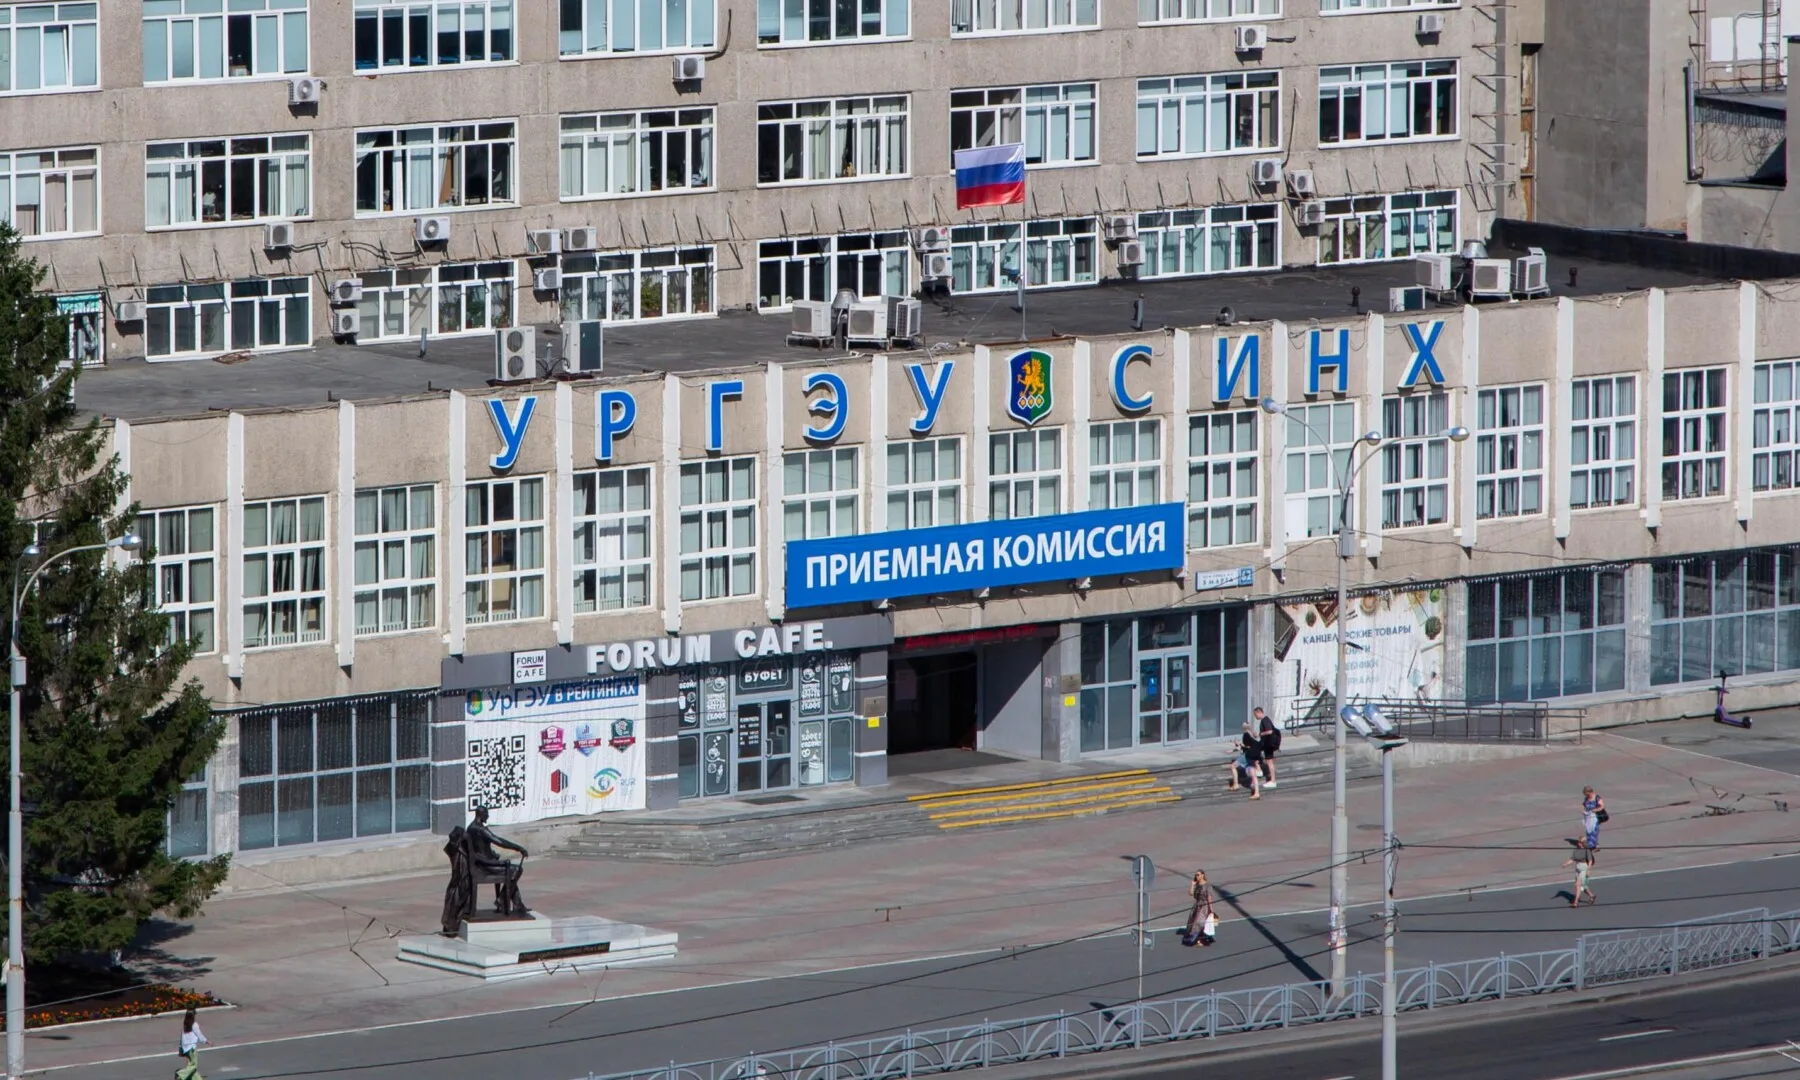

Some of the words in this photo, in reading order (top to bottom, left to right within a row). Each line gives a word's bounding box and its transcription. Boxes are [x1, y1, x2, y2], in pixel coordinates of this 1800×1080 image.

[806, 539, 984, 589] ПРИЕМНАЯ
[993, 520, 1166, 569] КОМИССИЯ
[586, 634, 711, 675] FORUM
[734, 622, 834, 658] CAFE.
[1303, 628, 1373, 645] КАНЦЕЛРСКИЕ
[1375, 625, 1412, 637] ТОВАРЫ
[516, 655, 545, 665] FORUM
[744, 668, 784, 683] БУФЕТ
[488, 684, 550, 716] УрГЭУ
[566, 680, 637, 701] РЕЙТИНГАХ
